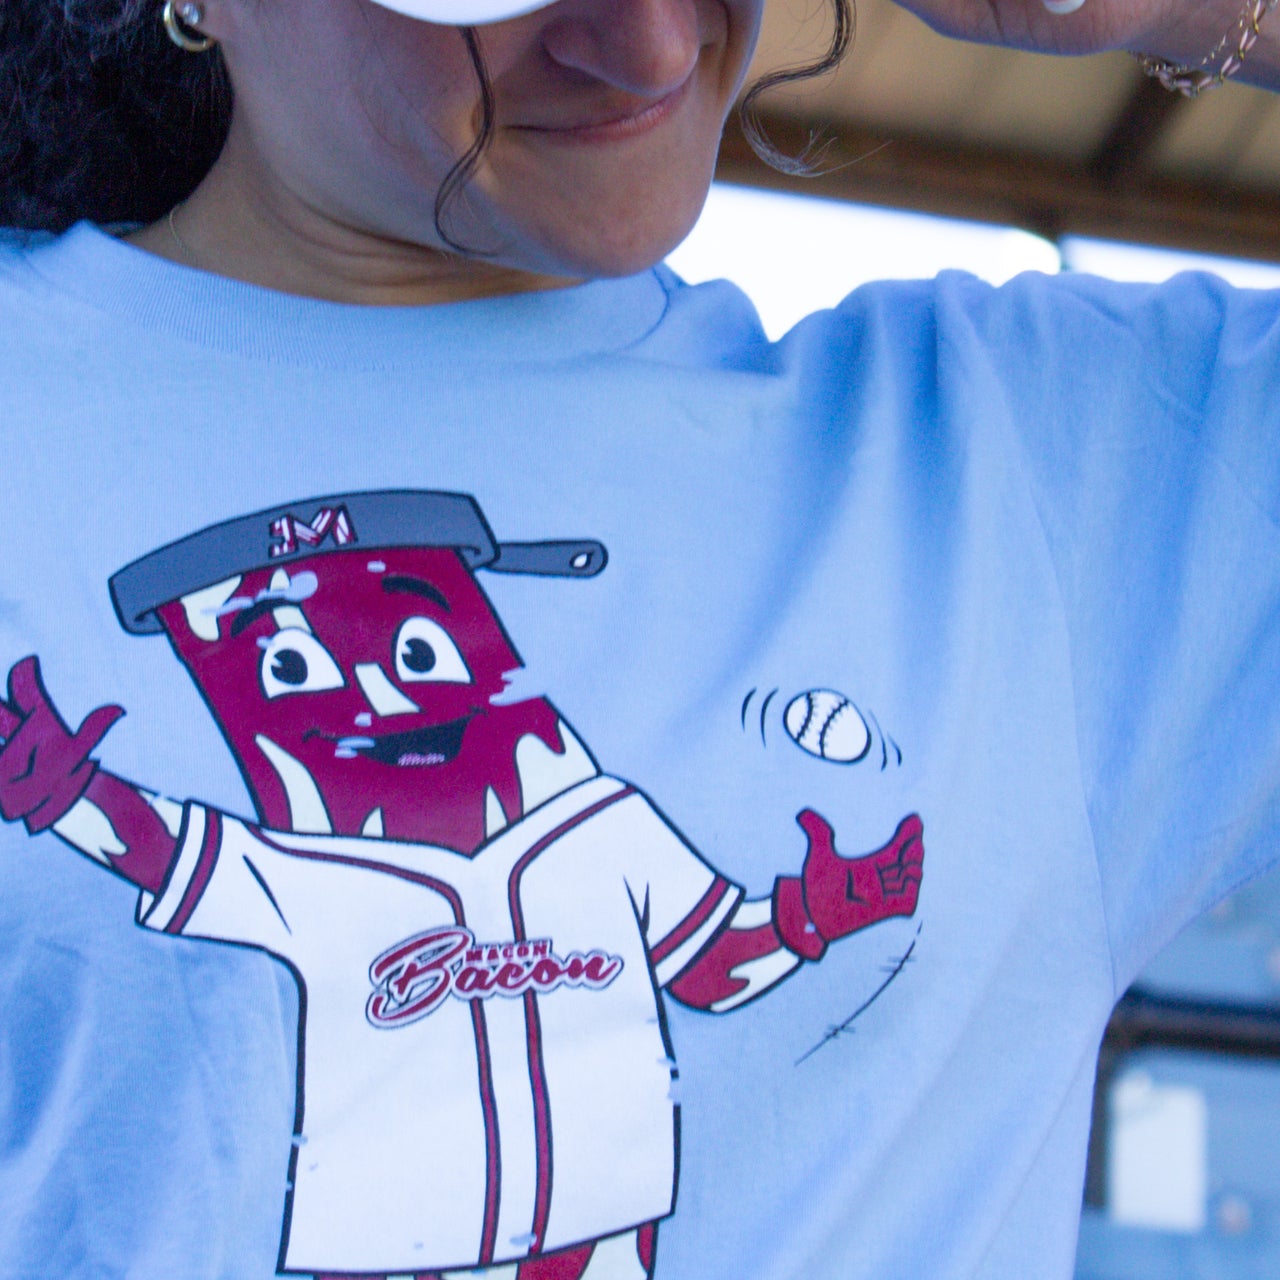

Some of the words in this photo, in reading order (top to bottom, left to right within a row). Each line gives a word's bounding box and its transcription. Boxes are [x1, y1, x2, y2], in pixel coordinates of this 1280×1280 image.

[269, 503, 358, 558] M
[368, 927, 621, 1027] Bacon
[465, 941, 549, 962] MACON
